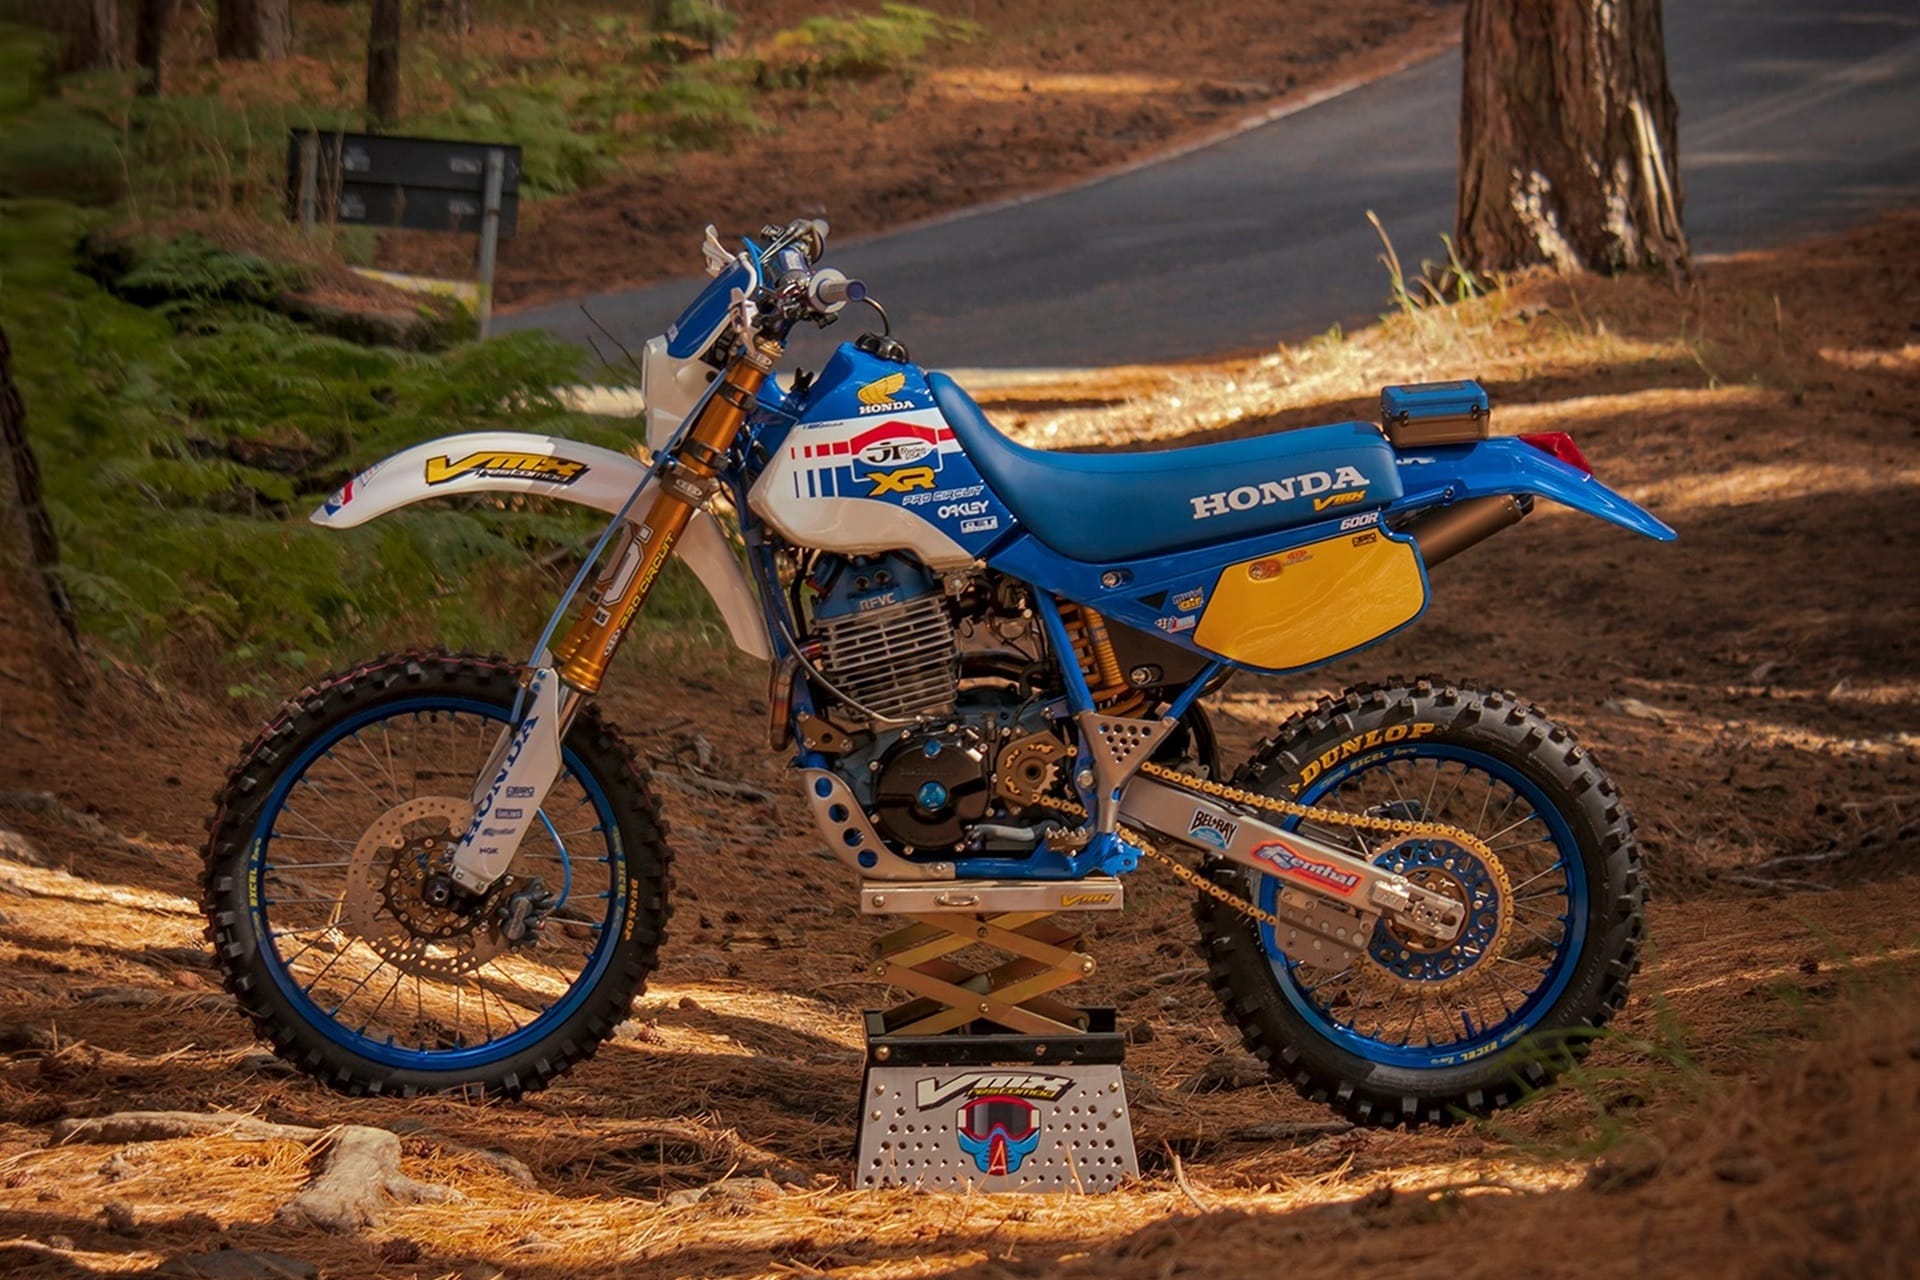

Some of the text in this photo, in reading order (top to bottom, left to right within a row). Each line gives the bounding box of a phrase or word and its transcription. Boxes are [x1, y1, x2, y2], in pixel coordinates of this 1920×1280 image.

[859, 400, 915, 414] HONDA
[867, 466, 936, 497] XR
[902, 485, 984, 506] PRO CIRCUIT
[1190, 466, 1371, 519] HONDA
[937, 500, 990, 519] OAKLEY
[1340, 511, 1379, 530] 600R
[620, 531, 675, 629] PRO CIRCUIT
[1300, 722, 1435, 787] DUNLOP
[461, 714, 540, 847] HONDA
[1253, 844, 1357, 889] Renthal
[624, 878, 639, 941] DUNLOP
